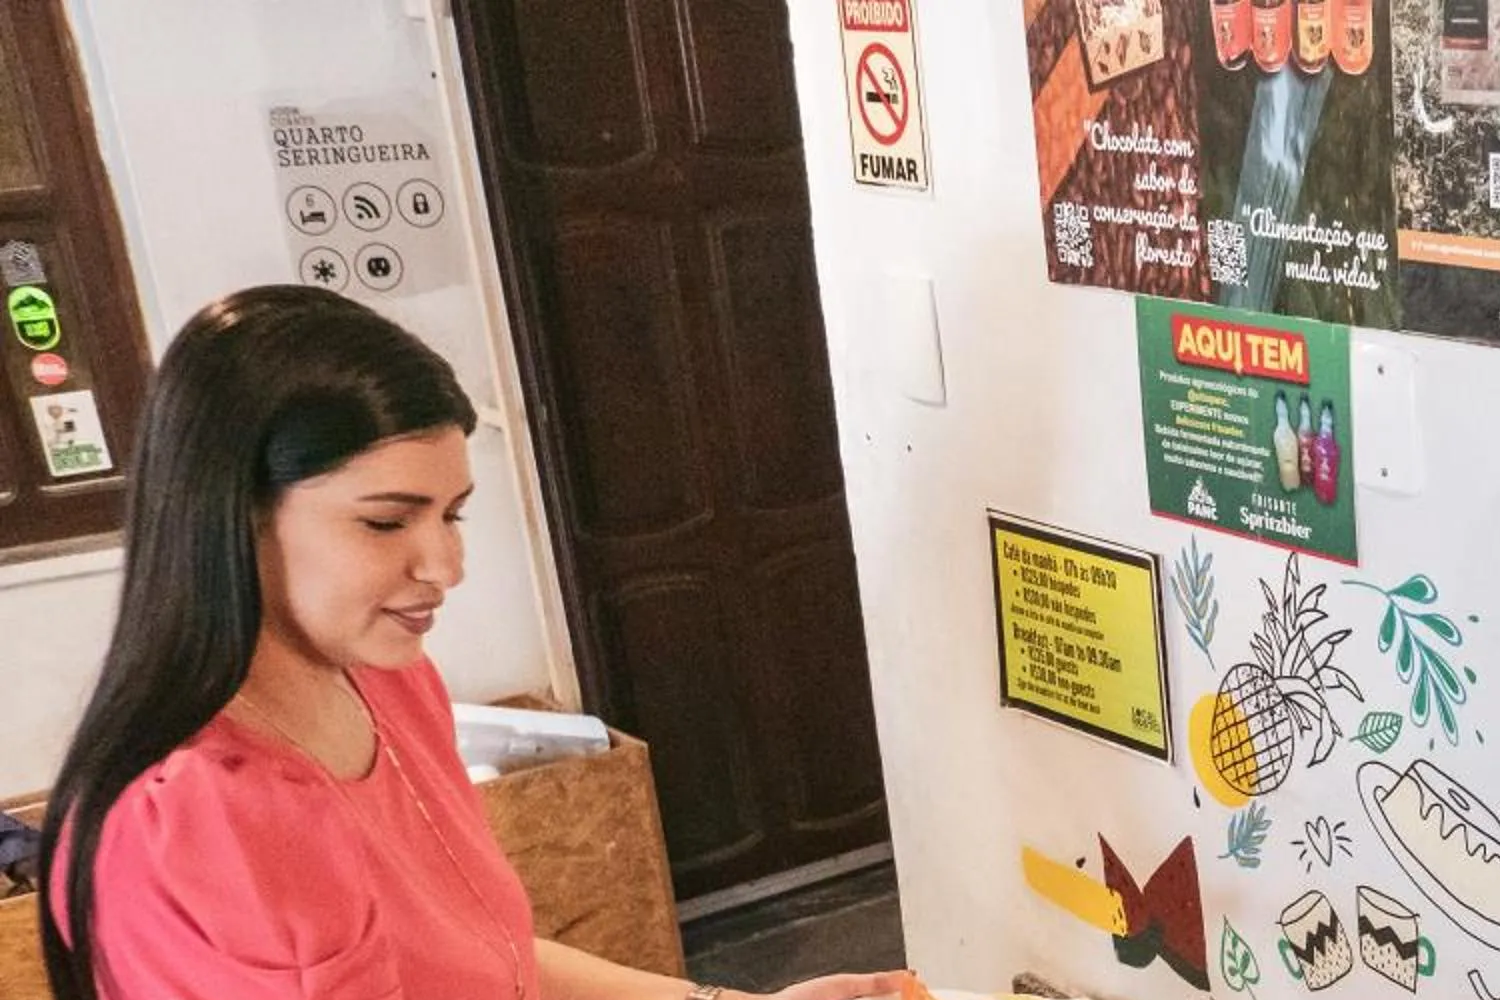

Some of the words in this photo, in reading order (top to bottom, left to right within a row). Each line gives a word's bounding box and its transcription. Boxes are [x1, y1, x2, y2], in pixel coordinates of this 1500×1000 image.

[846, 0, 904, 28] PROIBIDO
[273, 125, 364, 148] QUARTO
[1083, 119, 1163, 153] "Chocolate
[1164, 138, 1196, 157] com
[278, 143, 431, 168] SERINGUEIRA
[860, 153, 919, 183] FUMAR
[1134, 161, 1177, 192] sabor
[1177, 163, 1198, 195] de
[1093, 204, 1179, 235] conservação
[1180, 201, 1200, 232] da
[1242, 203, 1354, 253] "Alimentação
[1356, 230, 1389, 263] que
[1285, 250, 1332, 282] muda
[1177, 322, 1244, 373] AQUI
[1246, 333, 1304, 376] TEM
[1187, 500, 1218, 521] PANC
